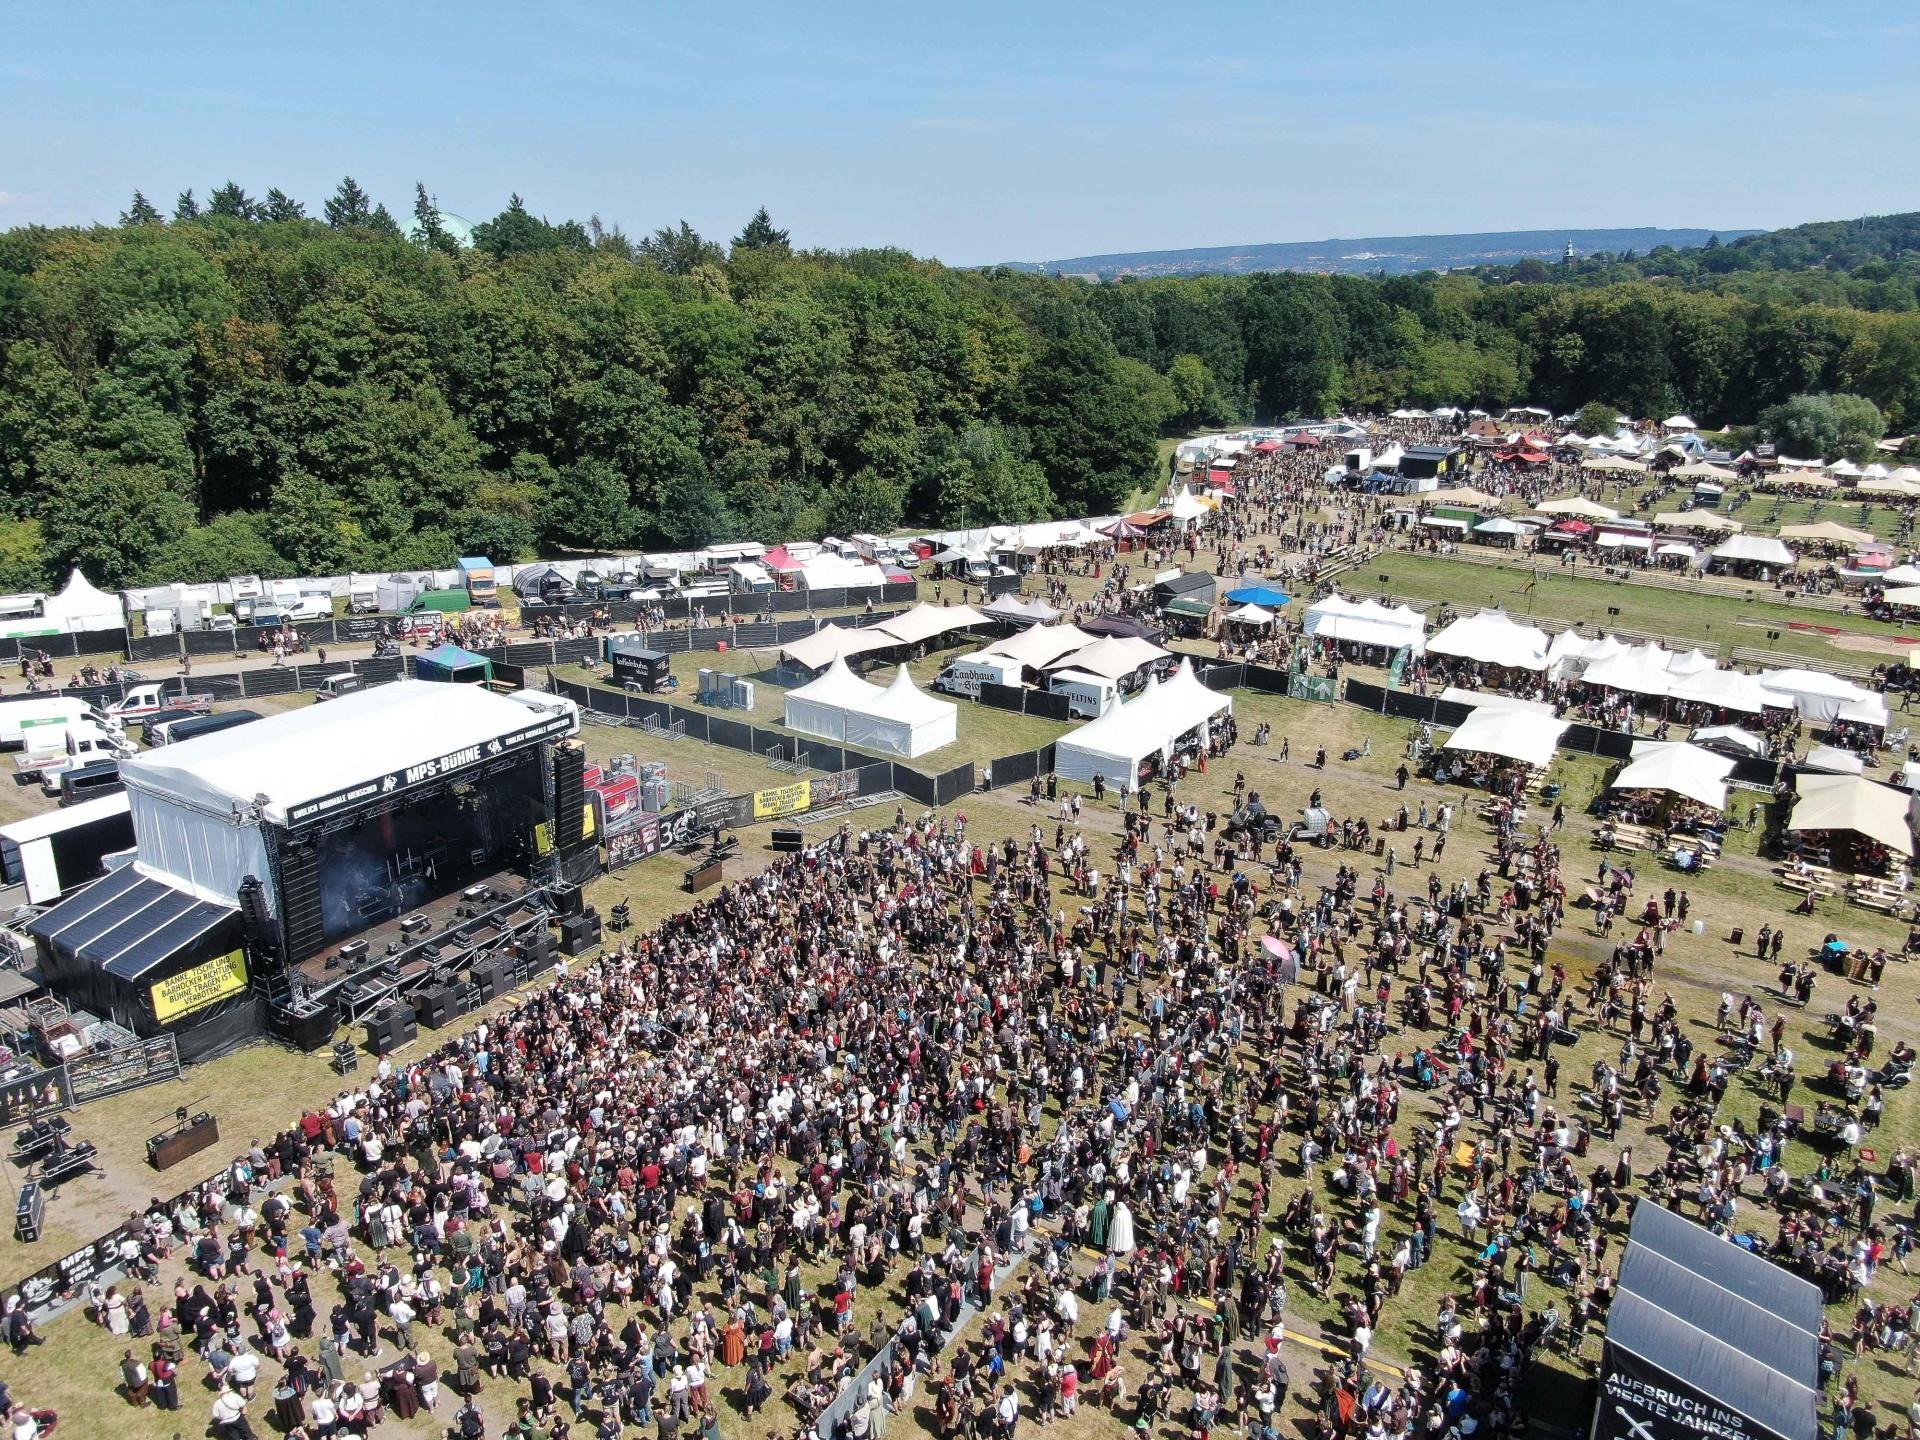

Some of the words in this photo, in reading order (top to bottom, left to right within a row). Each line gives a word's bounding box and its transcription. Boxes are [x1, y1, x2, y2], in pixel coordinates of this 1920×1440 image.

[954, 669, 995, 681] Landhaus
[192, 962, 215, 976] TISCHE
[215, 956, 231, 966] UND
[161, 976, 203, 998] BARHOCKER
[203, 962, 237, 980] RICHTUNG
[193, 977, 221, 993] TRAGEN
[221, 972, 232, 982] IST
[60, 1245, 95, 1270] MPS
[68, 1265, 95, 1284] 1994
[1604, 1383, 1668, 1418] VIERTE
[1671, 1411, 1758, 1440] JAHRZE
[1607, 1372, 1708, 1416] AUFBRUCH
[1711, 1407, 1743, 1428] INS
